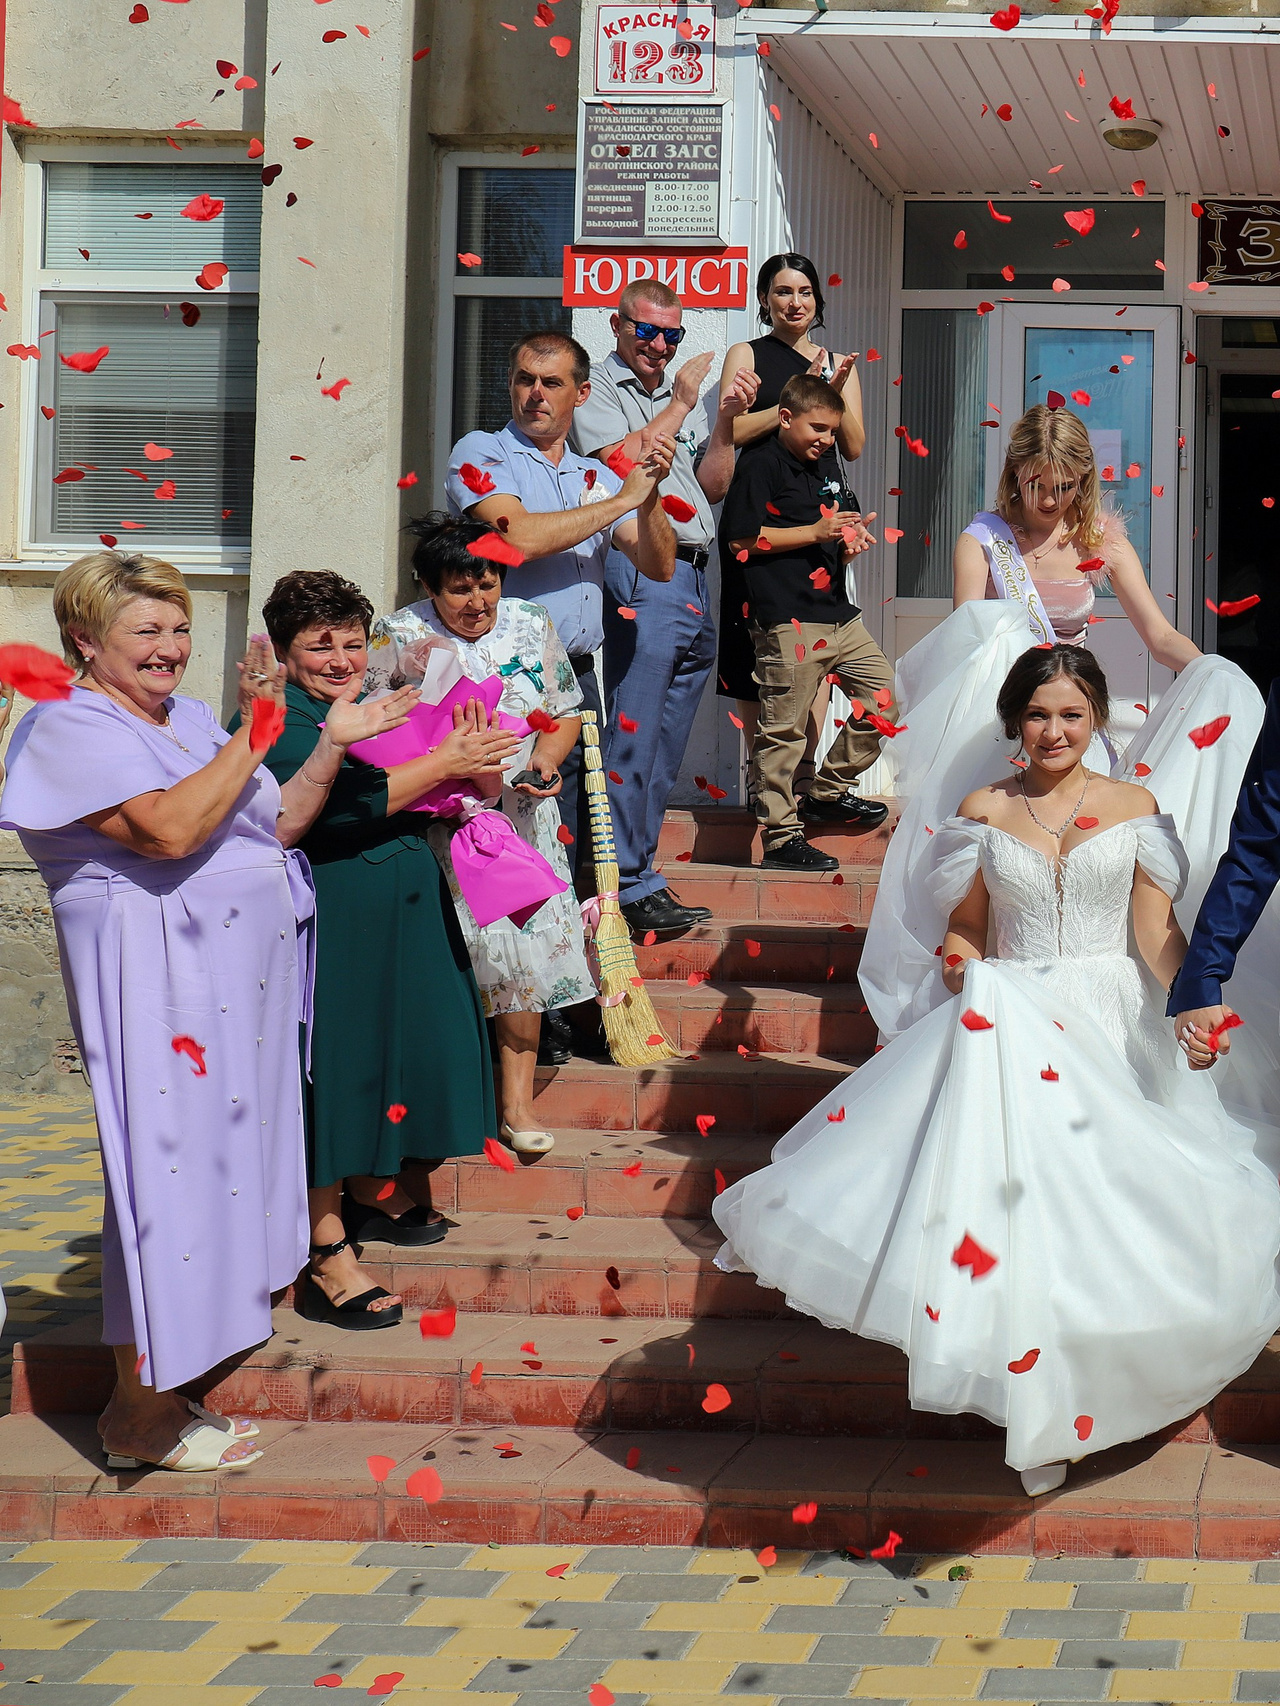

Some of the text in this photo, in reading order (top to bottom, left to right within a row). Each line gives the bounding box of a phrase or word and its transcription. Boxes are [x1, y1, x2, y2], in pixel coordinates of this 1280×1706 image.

[607, 40, 705, 85] 123
[659, 107, 716, 116] ФЕДЕРАЦИЯ
[588, 116, 722, 124] УПРАВЛЕНИЕ ЗАПИСИ АКТОВ
[588, 125, 722, 133] ГРАЖДАНСКОГО СОСТОЯНИЯ
[597, 133, 712, 142] КРАСНОДАРСКОГО КРАЯ
[664, 144, 718, 159] ЗАГС
[588, 161, 719, 170] БЕЛОГЛИНСКОГО РАЙОНА
[617, 172, 690, 180] РЕЖИМ РАБОТЫ
[587, 183, 709, 192] ежедневно 8.00-17.00
[587, 194, 709, 203] пятница 8.00-16.00
[587, 204, 712, 214] перерыв 12.00-12.50
[586, 219, 639, 228] выходной
[648, 216, 715, 224] воскресенье
[573, 257, 748, 296] ЮРИСТ
